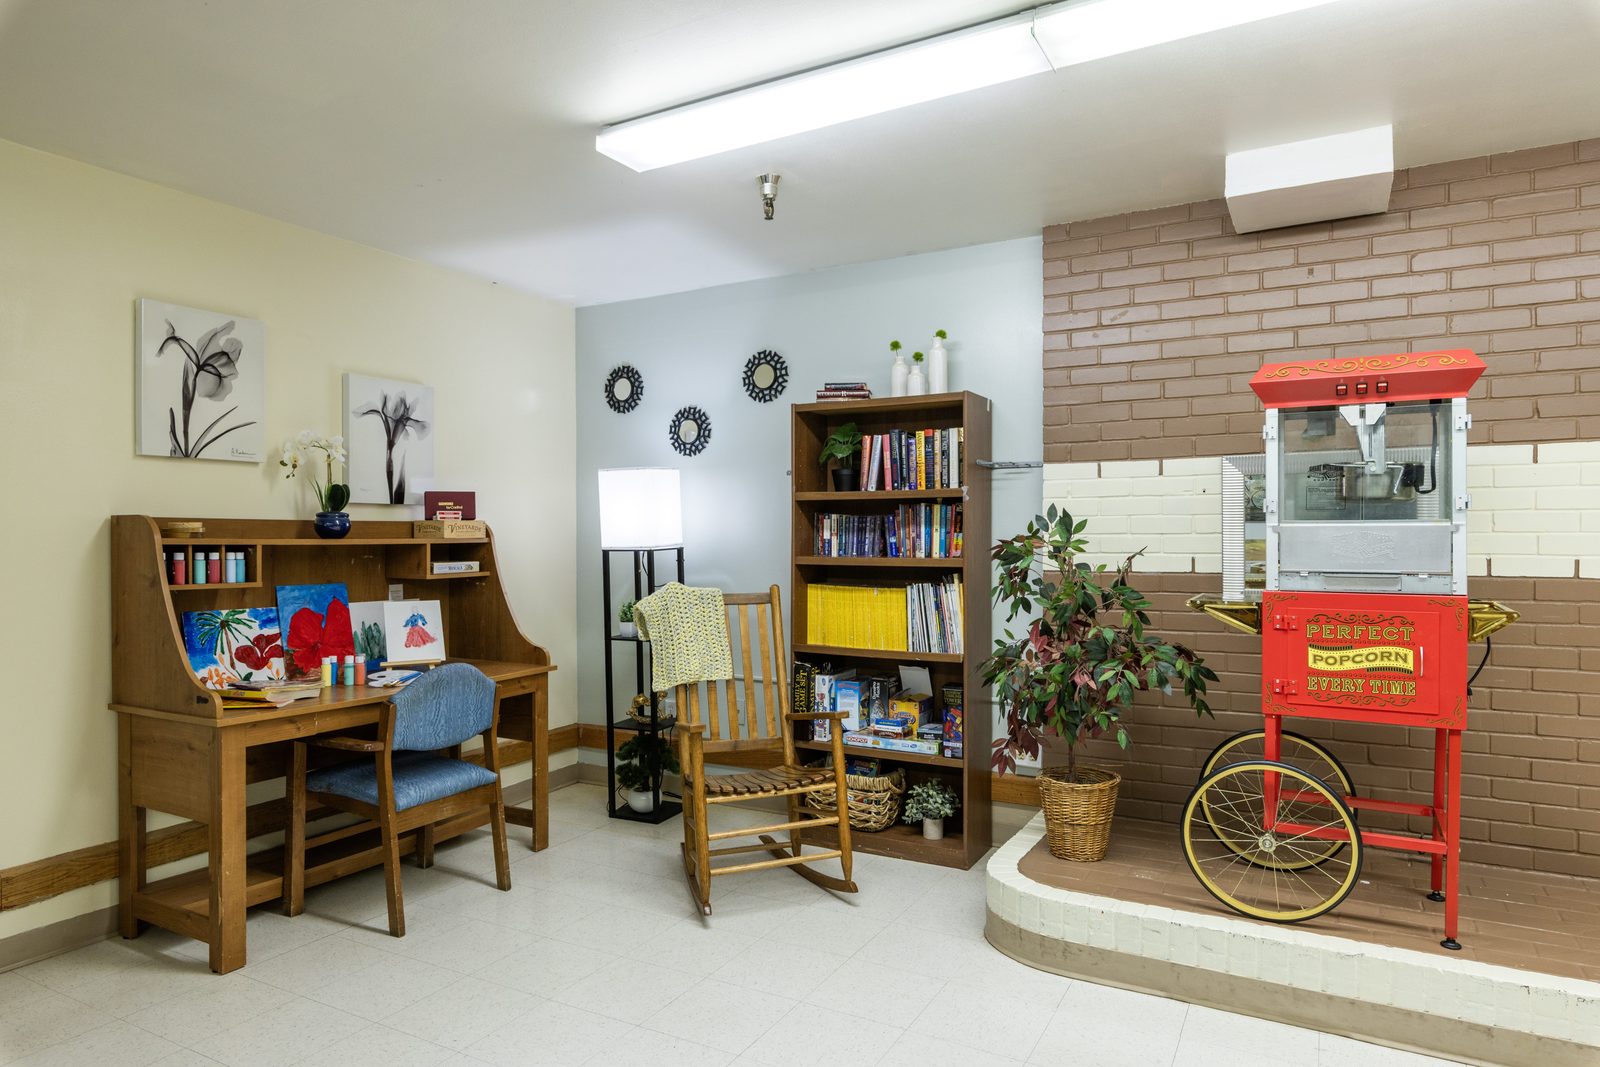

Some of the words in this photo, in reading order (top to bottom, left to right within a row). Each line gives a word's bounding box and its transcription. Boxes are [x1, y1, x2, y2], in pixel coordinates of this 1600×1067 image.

[1306, 624, 1415, 641] PERFECT
[1312, 651, 1410, 666] POPCORN
[799, 670, 807, 687] SET
[1307, 676, 1366, 693] EVERY
[1370, 679, 1416, 696] TIME
[799, 688, 807, 713] GAME
